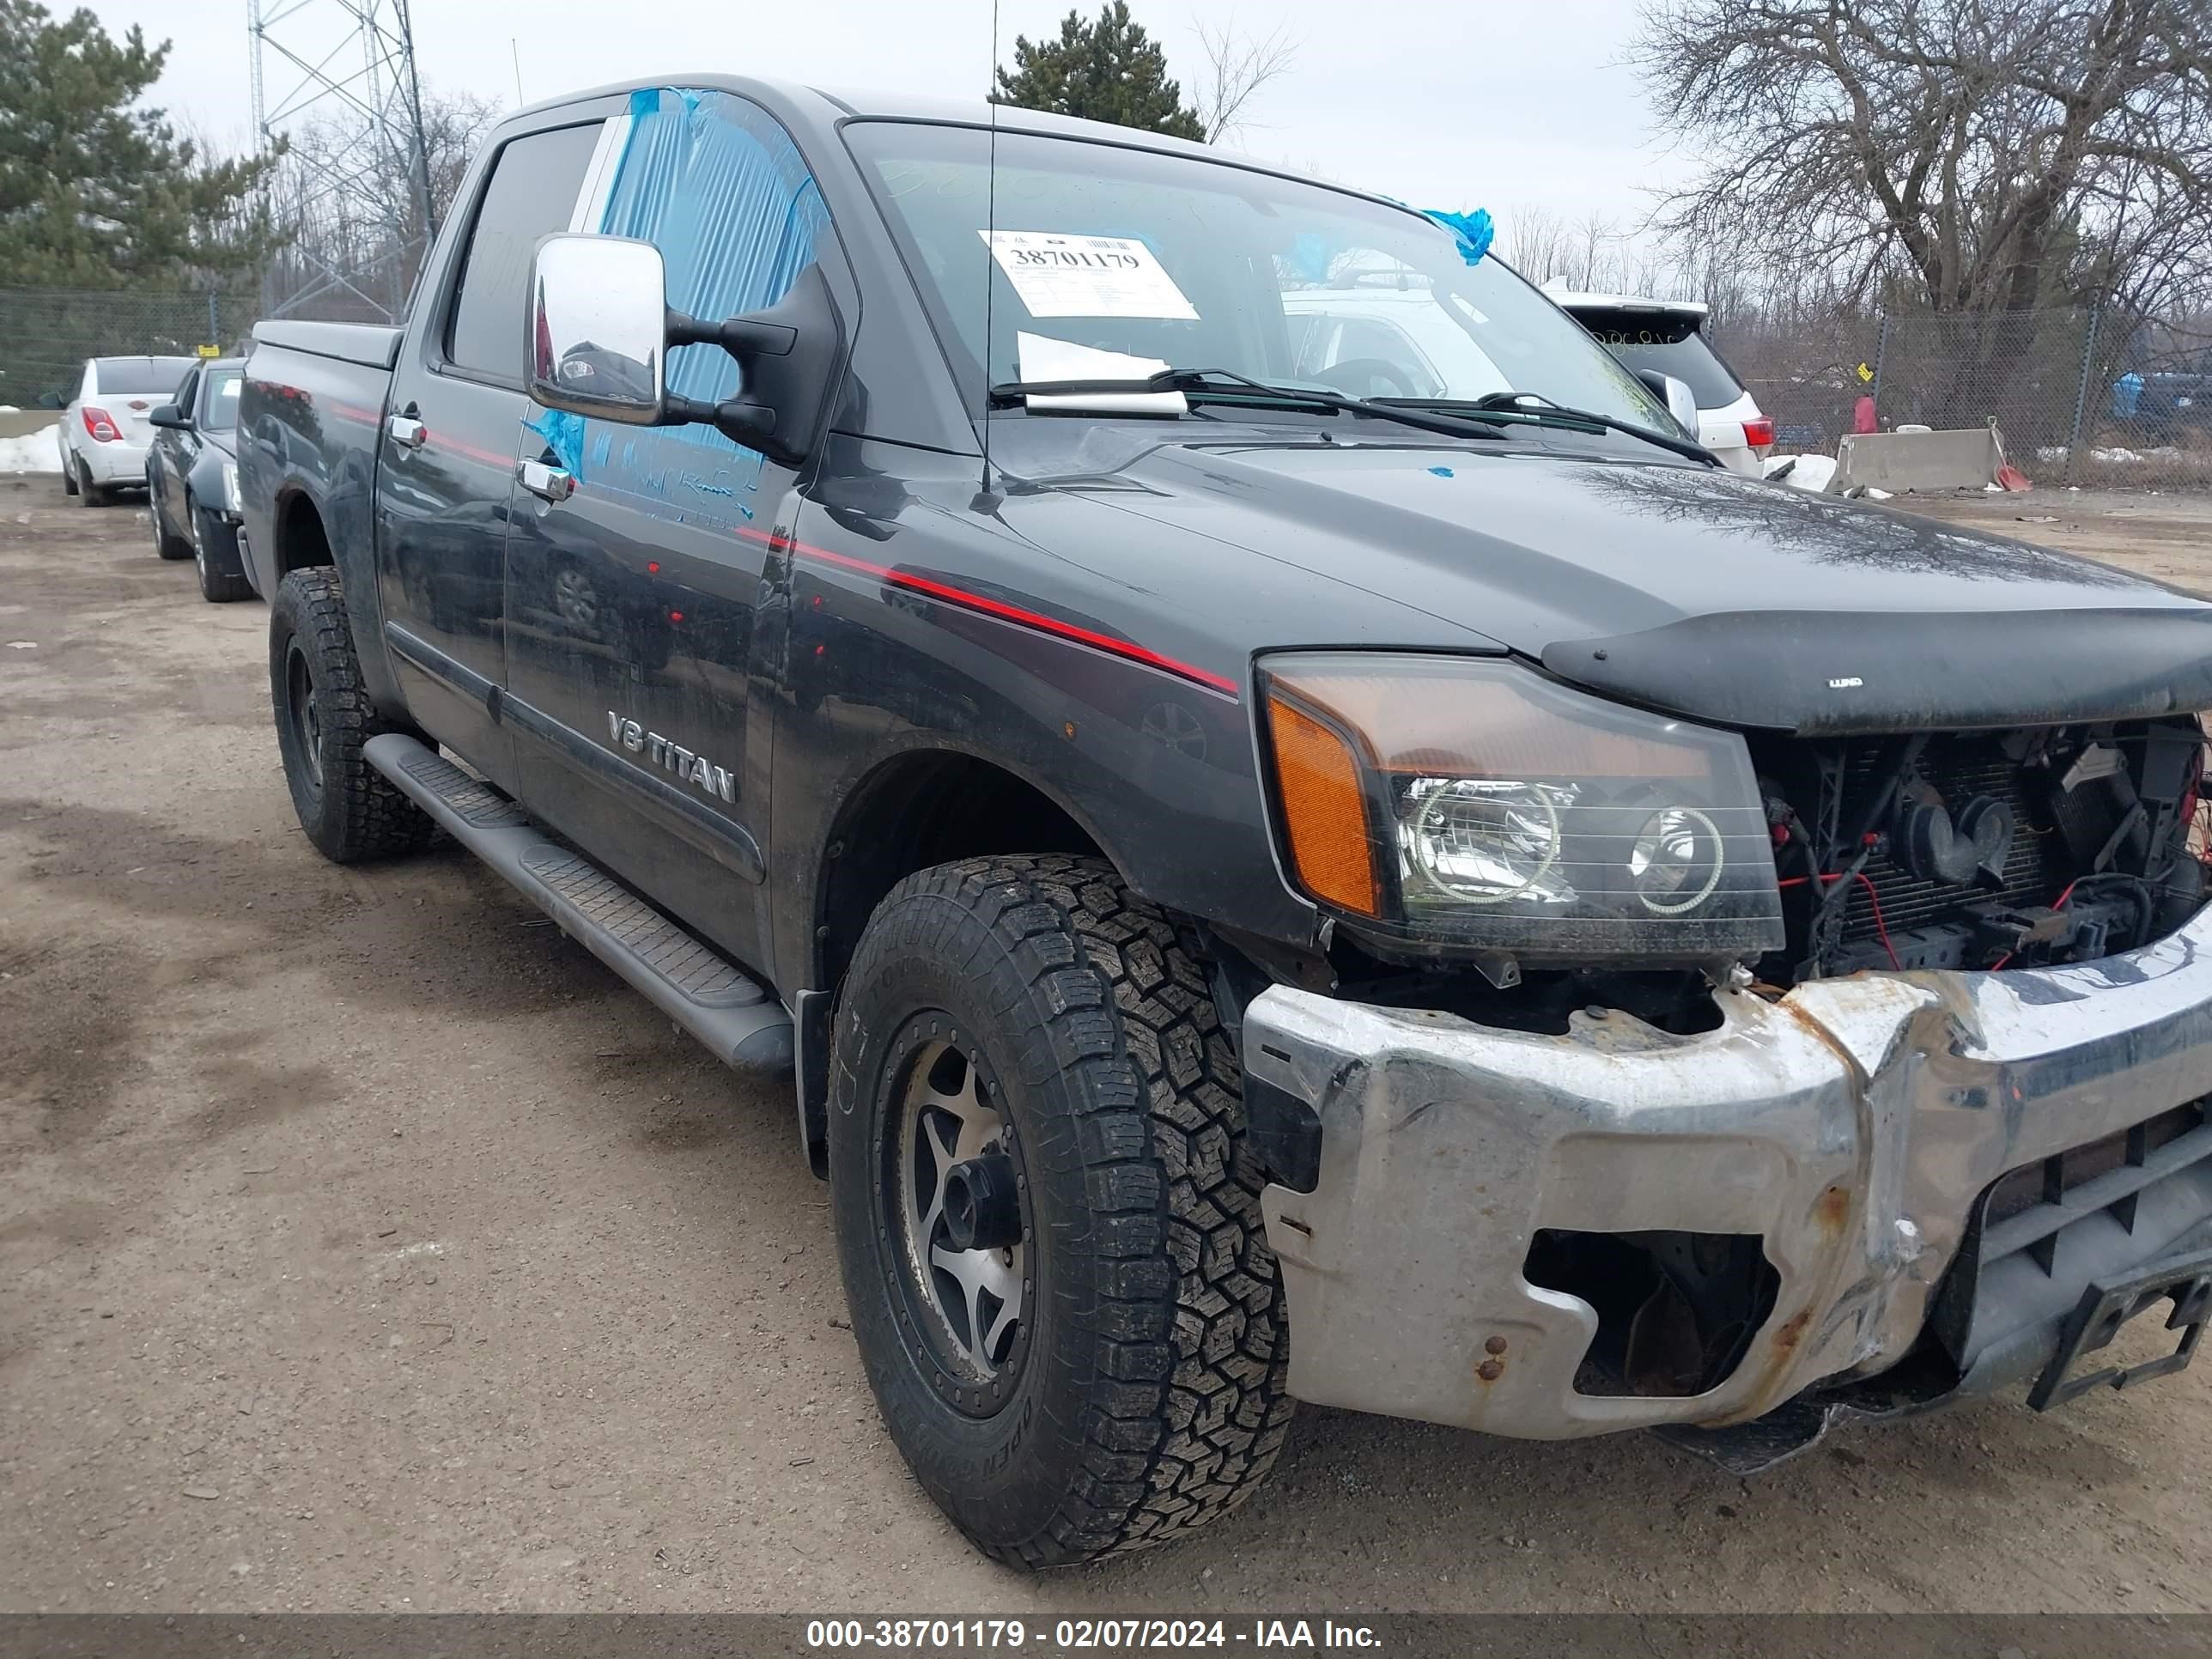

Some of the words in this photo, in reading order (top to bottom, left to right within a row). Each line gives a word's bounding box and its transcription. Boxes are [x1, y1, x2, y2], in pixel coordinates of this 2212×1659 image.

[1010, 249, 1139, 269] 38701179
[608, 710, 644, 752] V8
[648, 731, 736, 804] TITAN
